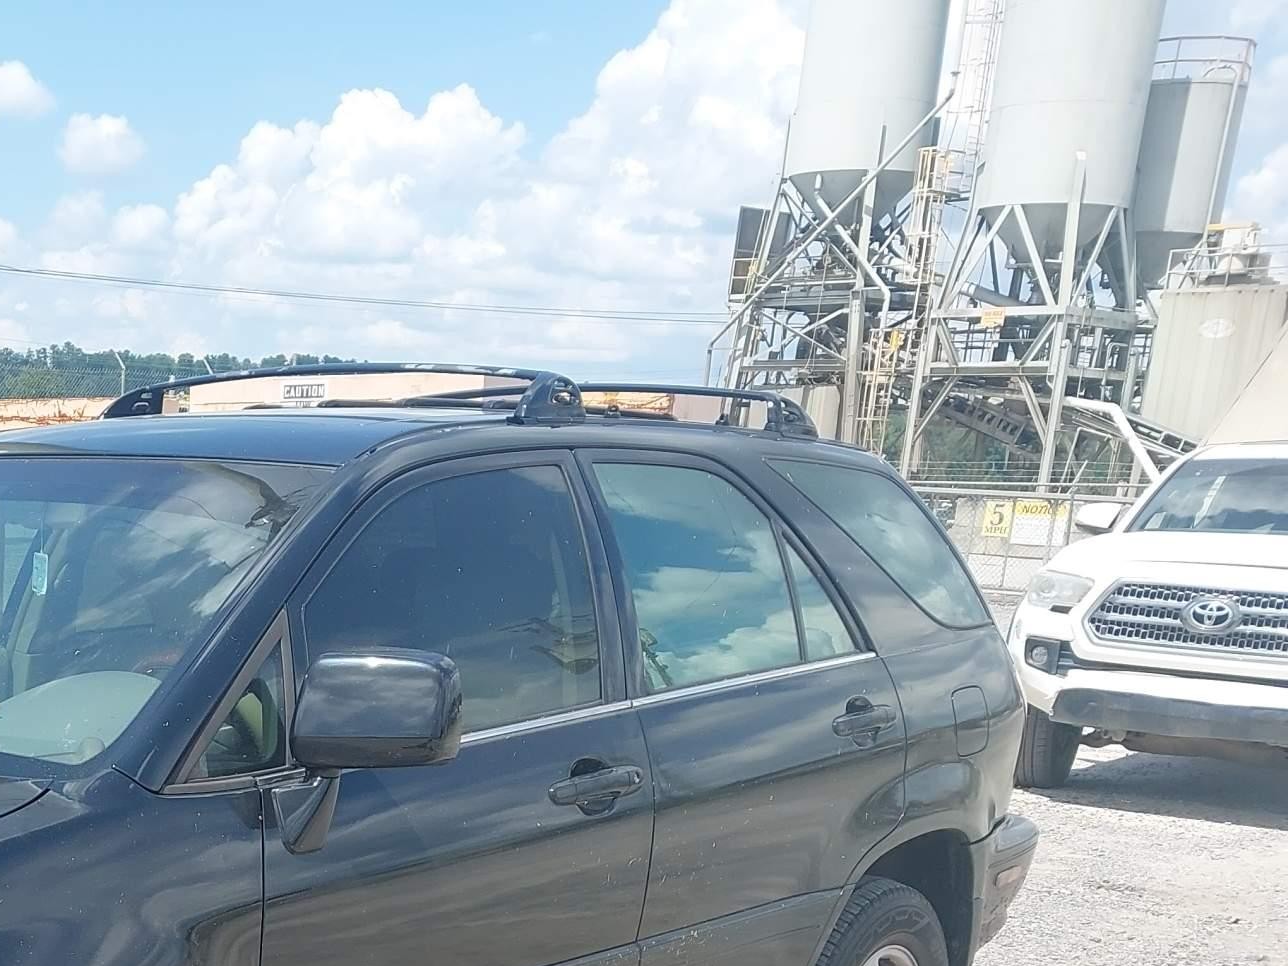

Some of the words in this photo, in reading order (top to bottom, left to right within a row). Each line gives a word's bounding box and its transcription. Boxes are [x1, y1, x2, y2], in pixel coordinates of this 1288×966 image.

[284, 384, 324, 398] CAUTION
[990, 503, 1005, 526] 5
[1022, 503, 1059, 515] NOTIC
[984, 526, 1008, 534] MPH
